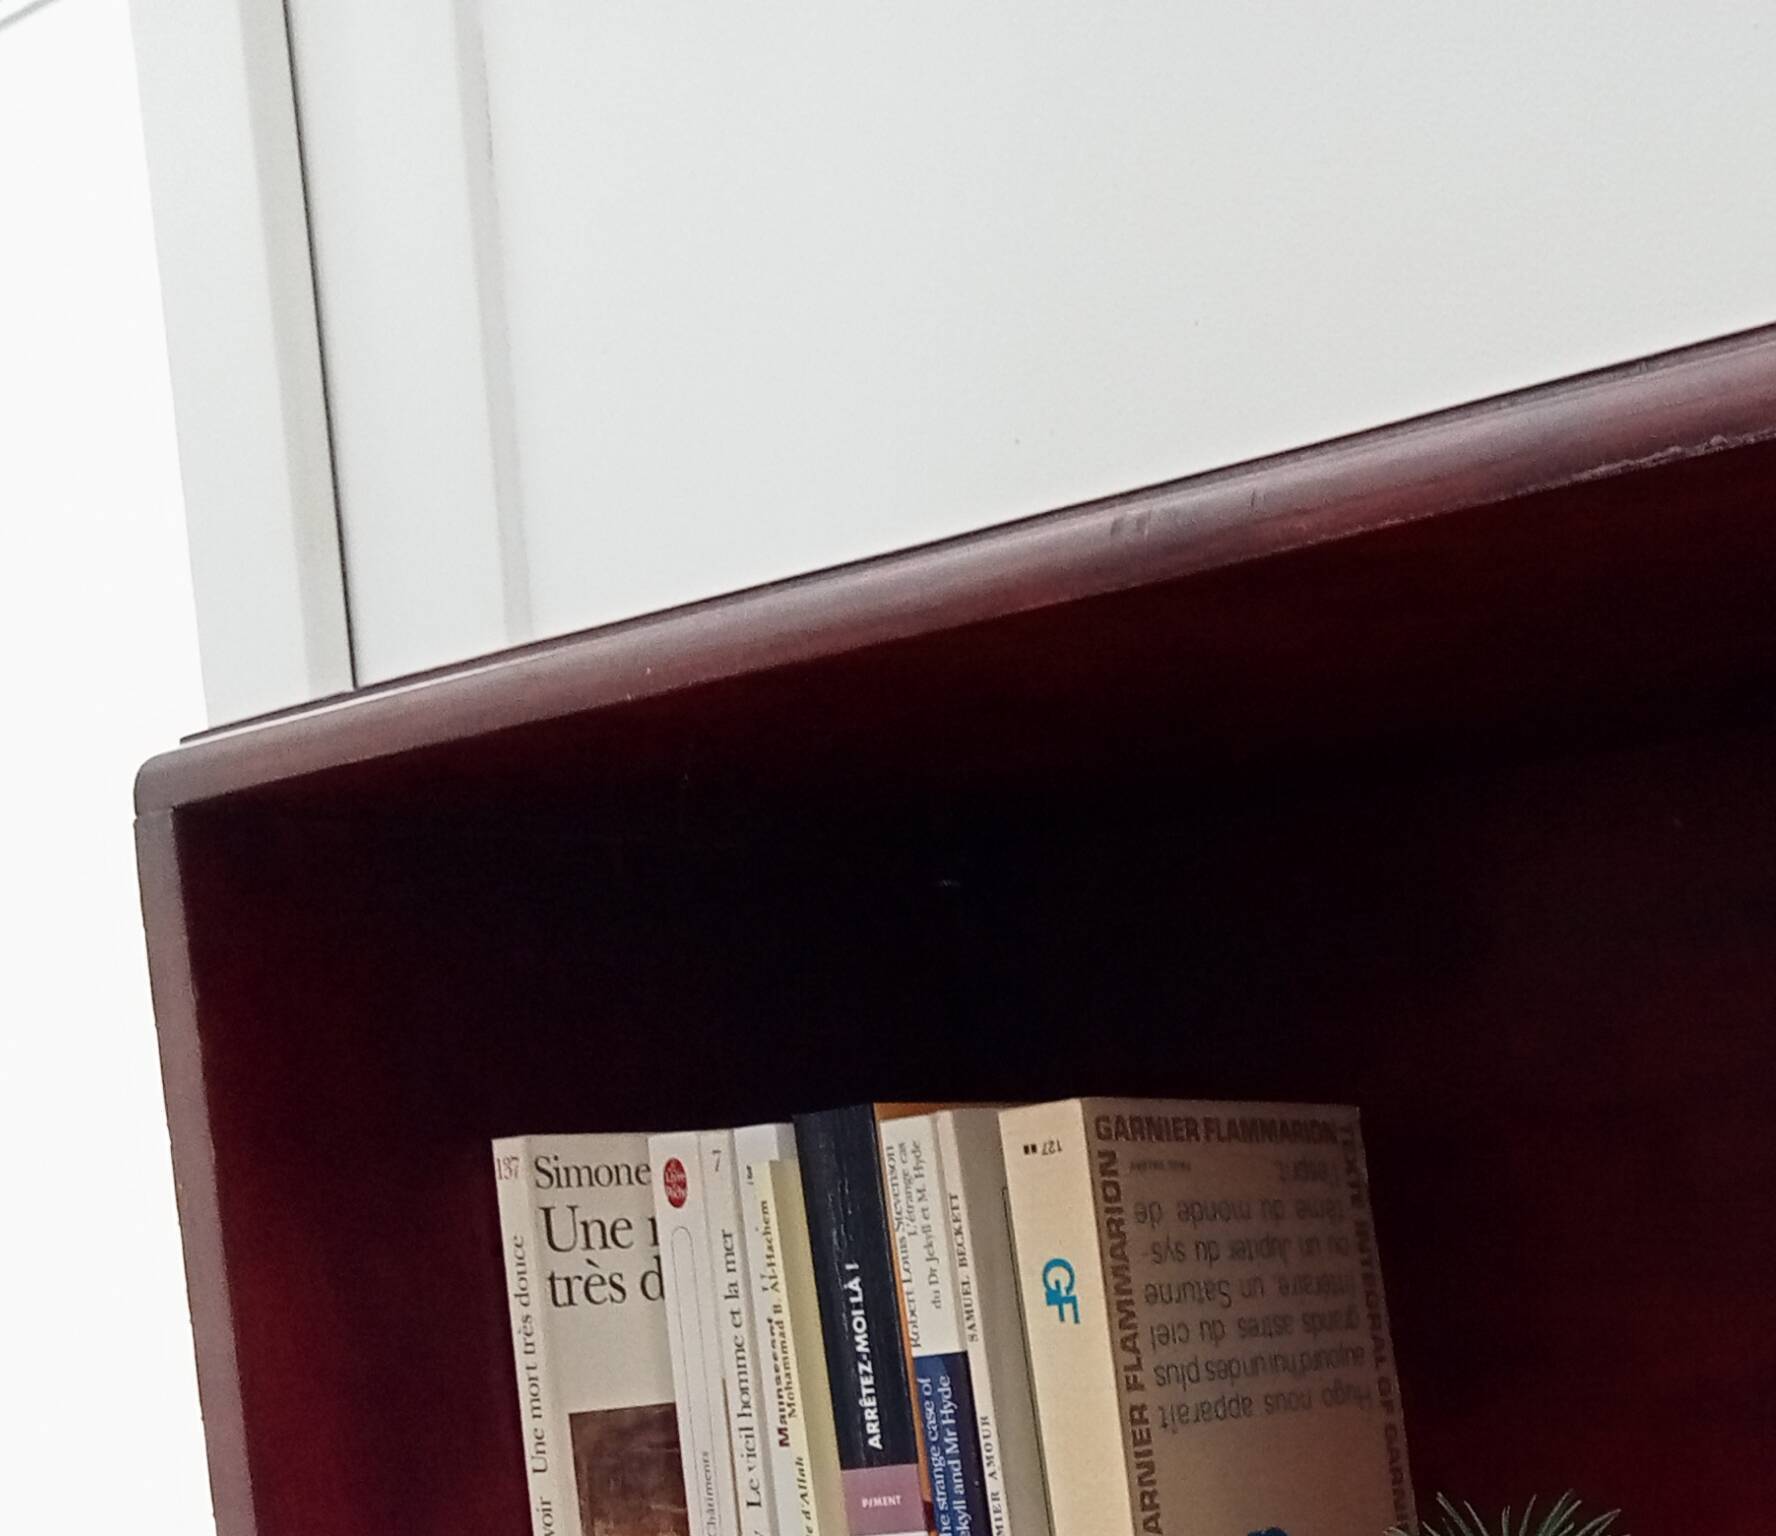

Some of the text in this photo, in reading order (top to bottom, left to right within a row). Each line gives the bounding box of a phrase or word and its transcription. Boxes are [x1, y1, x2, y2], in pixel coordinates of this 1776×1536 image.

[1094, 1115, 1338, 1144] GARNIER FLAMMARION
[896, 1141, 908, 1165] cas
[910, 1139, 926, 1179] Hyde
[1041, 1139, 1063, 1157] 127
[495, 1156, 520, 1181] 187
[534, 1155, 652, 1190] Simone
[539, 1204, 636, 1254] Une
[921, 1206, 932, 1220] et
[1133, 1201, 1163, 1229] de
[1177, 1200, 1252, 1228] monde
[721, 1229, 736, 1273] mer
[883, 1144, 922, 1349] Robert Louis Stevenson
[920, 1224, 940, 1264] Jekyll
[1195, 1240, 1220, 1267] du
[547, 1256, 627, 1308] très
[928, 1266, 941, 1286] Dr
[948, 1192, 980, 1343] SAMUEL BECKETT
[1099, 1149, 1146, 1391] FLAMMARION
[724, 1278, 739, 1300] la
[930, 1288, 942, 1310] du
[1042, 1257, 1080, 1324] GF
[1144, 1279, 1232, 1309] Saturne
[729, 1307, 743, 1328] et
[1199, 1320, 1226, 1348] du
[1149, 1322, 1190, 1350] ciel
[512, 1233, 548, 1475] Une mort très douce
[774, 1320, 798, 1419] Mohammad
[733, 1334, 754, 1418] homme
[917, 1377, 933, 1396] of
[1153, 1357, 1201, 1391] plus
[938, 1375, 958, 1424] Hyde
[923, 1399, 939, 1440] case
[736, 1425, 756, 1472] vieil
[944, 1427, 960, 1455] Mr
[979, 1415, 999, 1481] AMOUR
[745, 1478, 763, 1509] Le
[931, 1445, 950, 1511] strange
[948, 1459, 965, 1495] and
